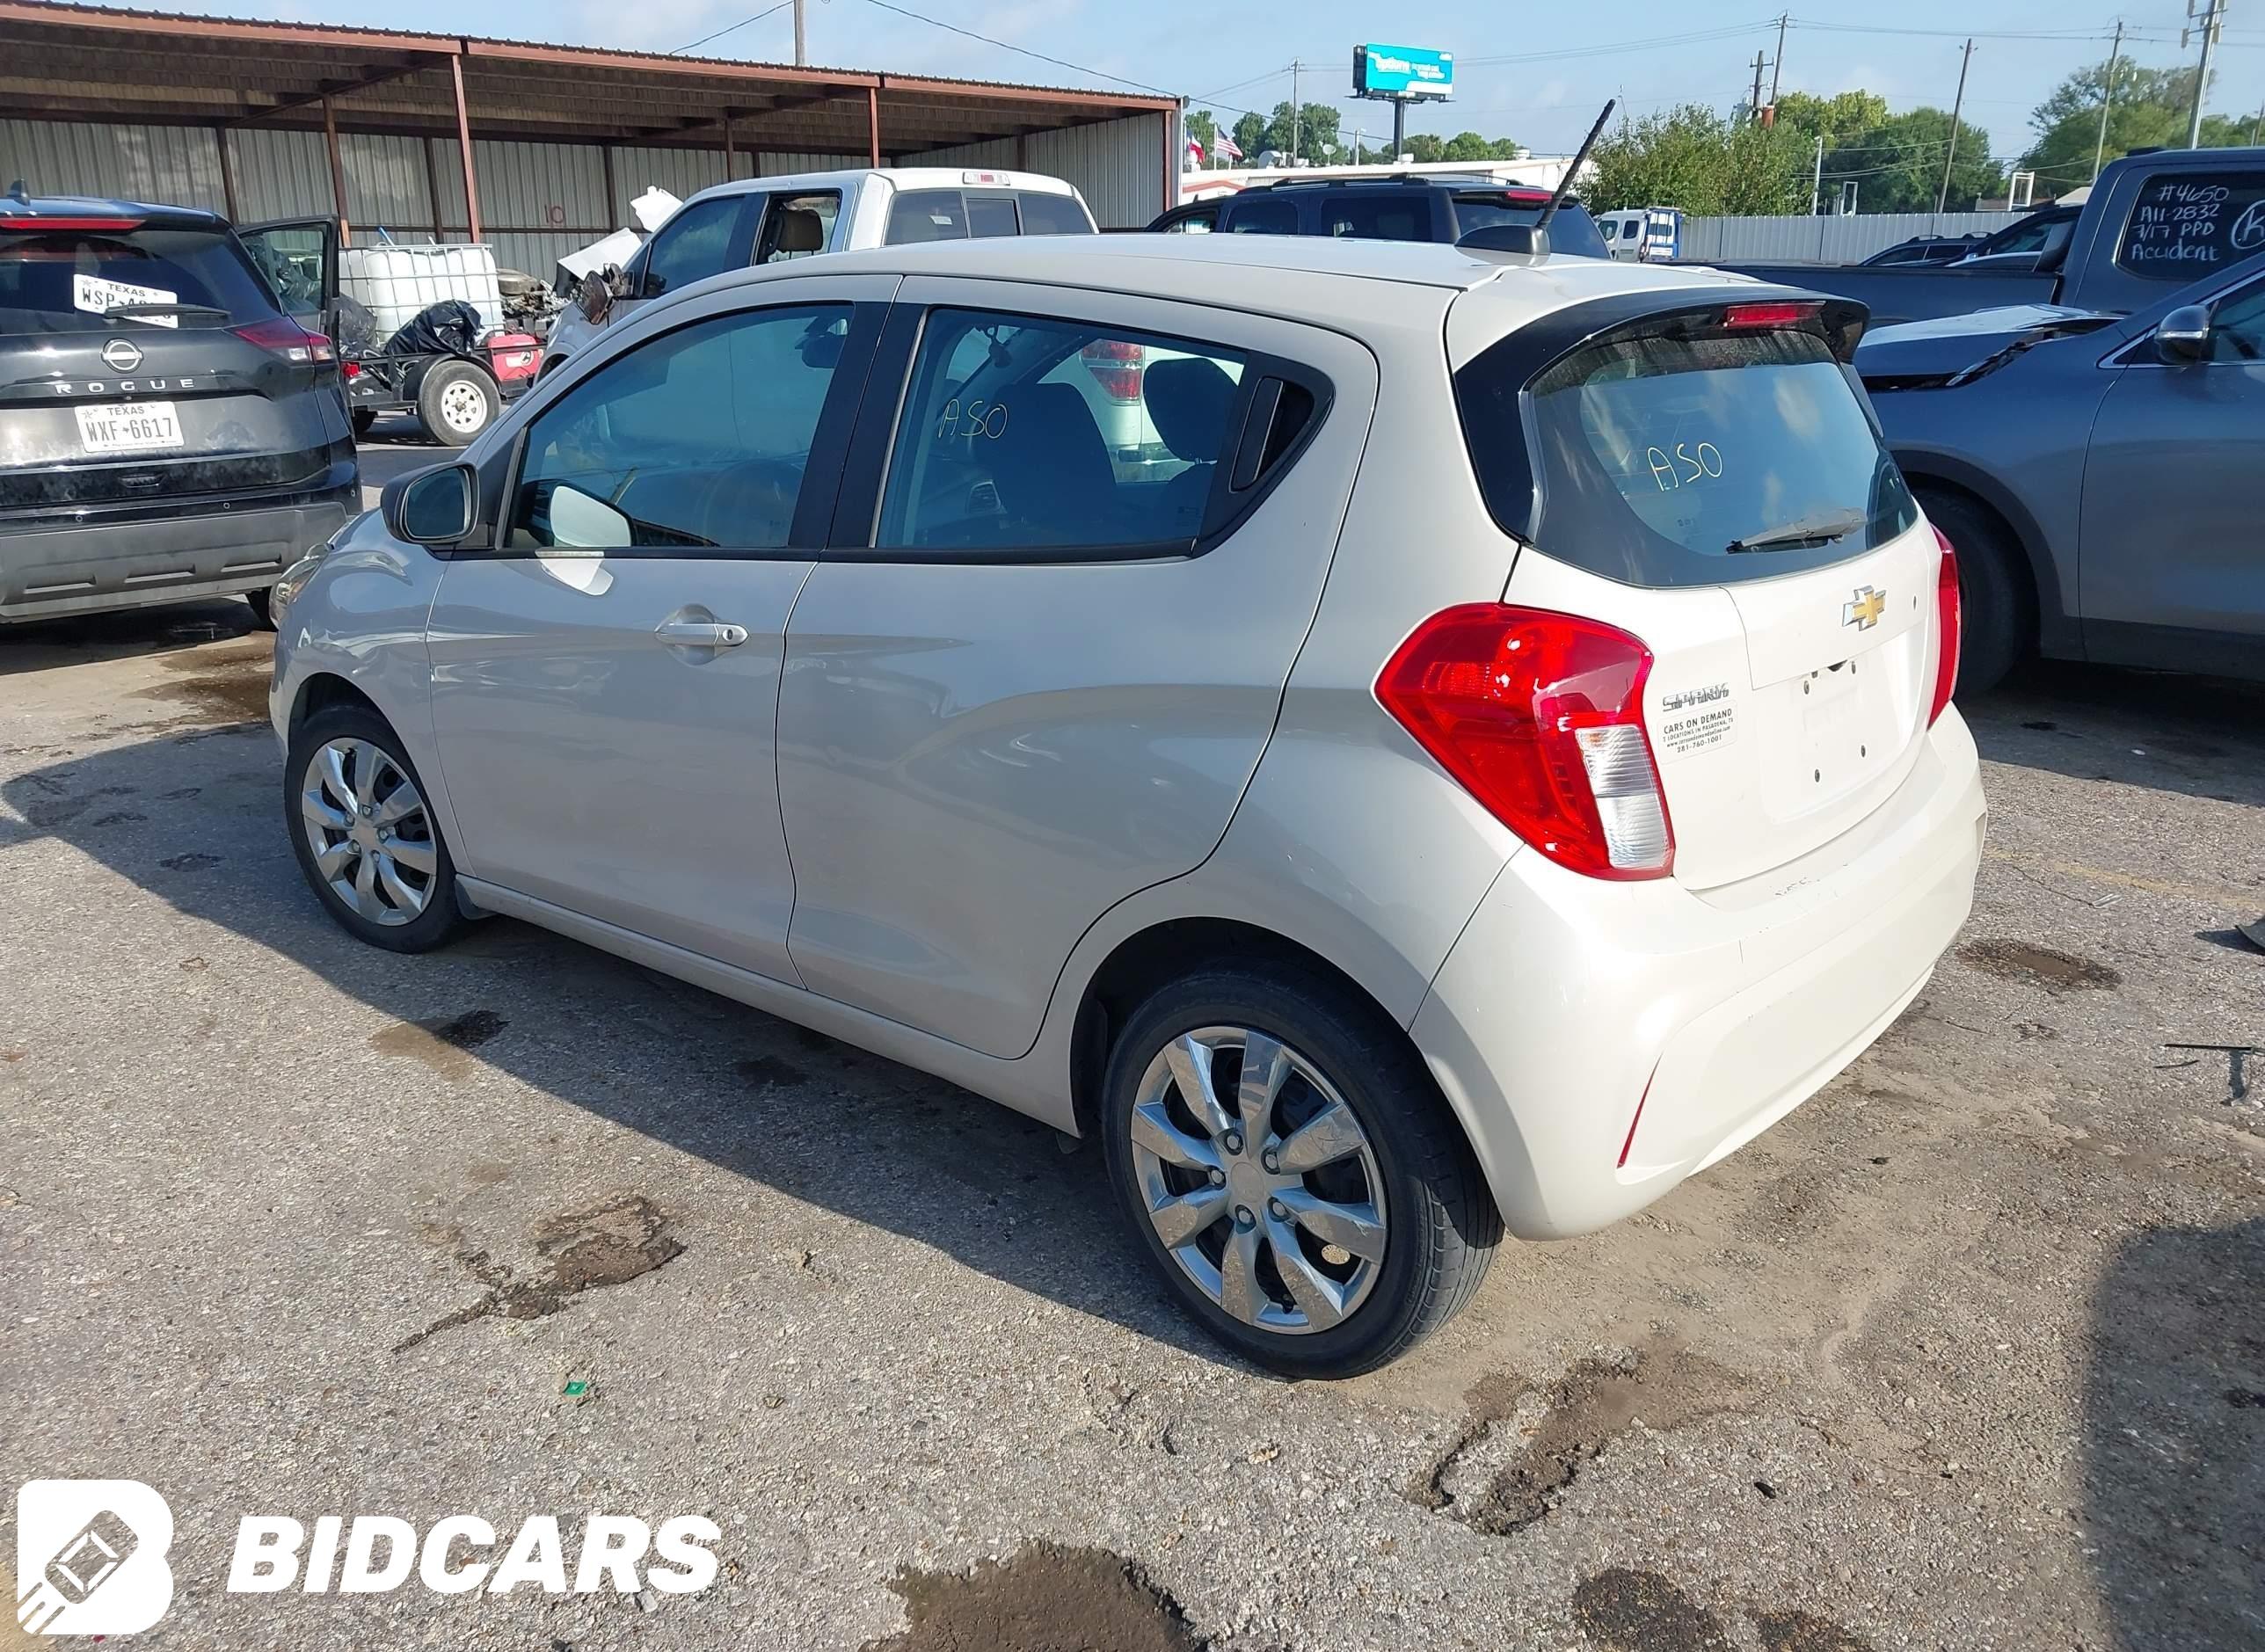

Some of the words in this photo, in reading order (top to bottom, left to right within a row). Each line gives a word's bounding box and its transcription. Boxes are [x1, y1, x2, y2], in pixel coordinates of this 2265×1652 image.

[2158, 183, 2230, 202] #4650
[2131, 224, 2171, 242] 7/17
[2180, 222, 2216, 237] PPD
[107, 282, 146, 297] TEXAS
[55, 378, 195, 395] ROGUE
[106, 405, 145, 417] TEXAS
[1662, 682, 1730, 711] SPARK
[1664, 721, 1684, 734] CARS
[1686, 717, 1698, 729] ON
[1701, 708, 1732, 724] DEMAND
[1667, 728, 1694, 741] LOCATIONS
